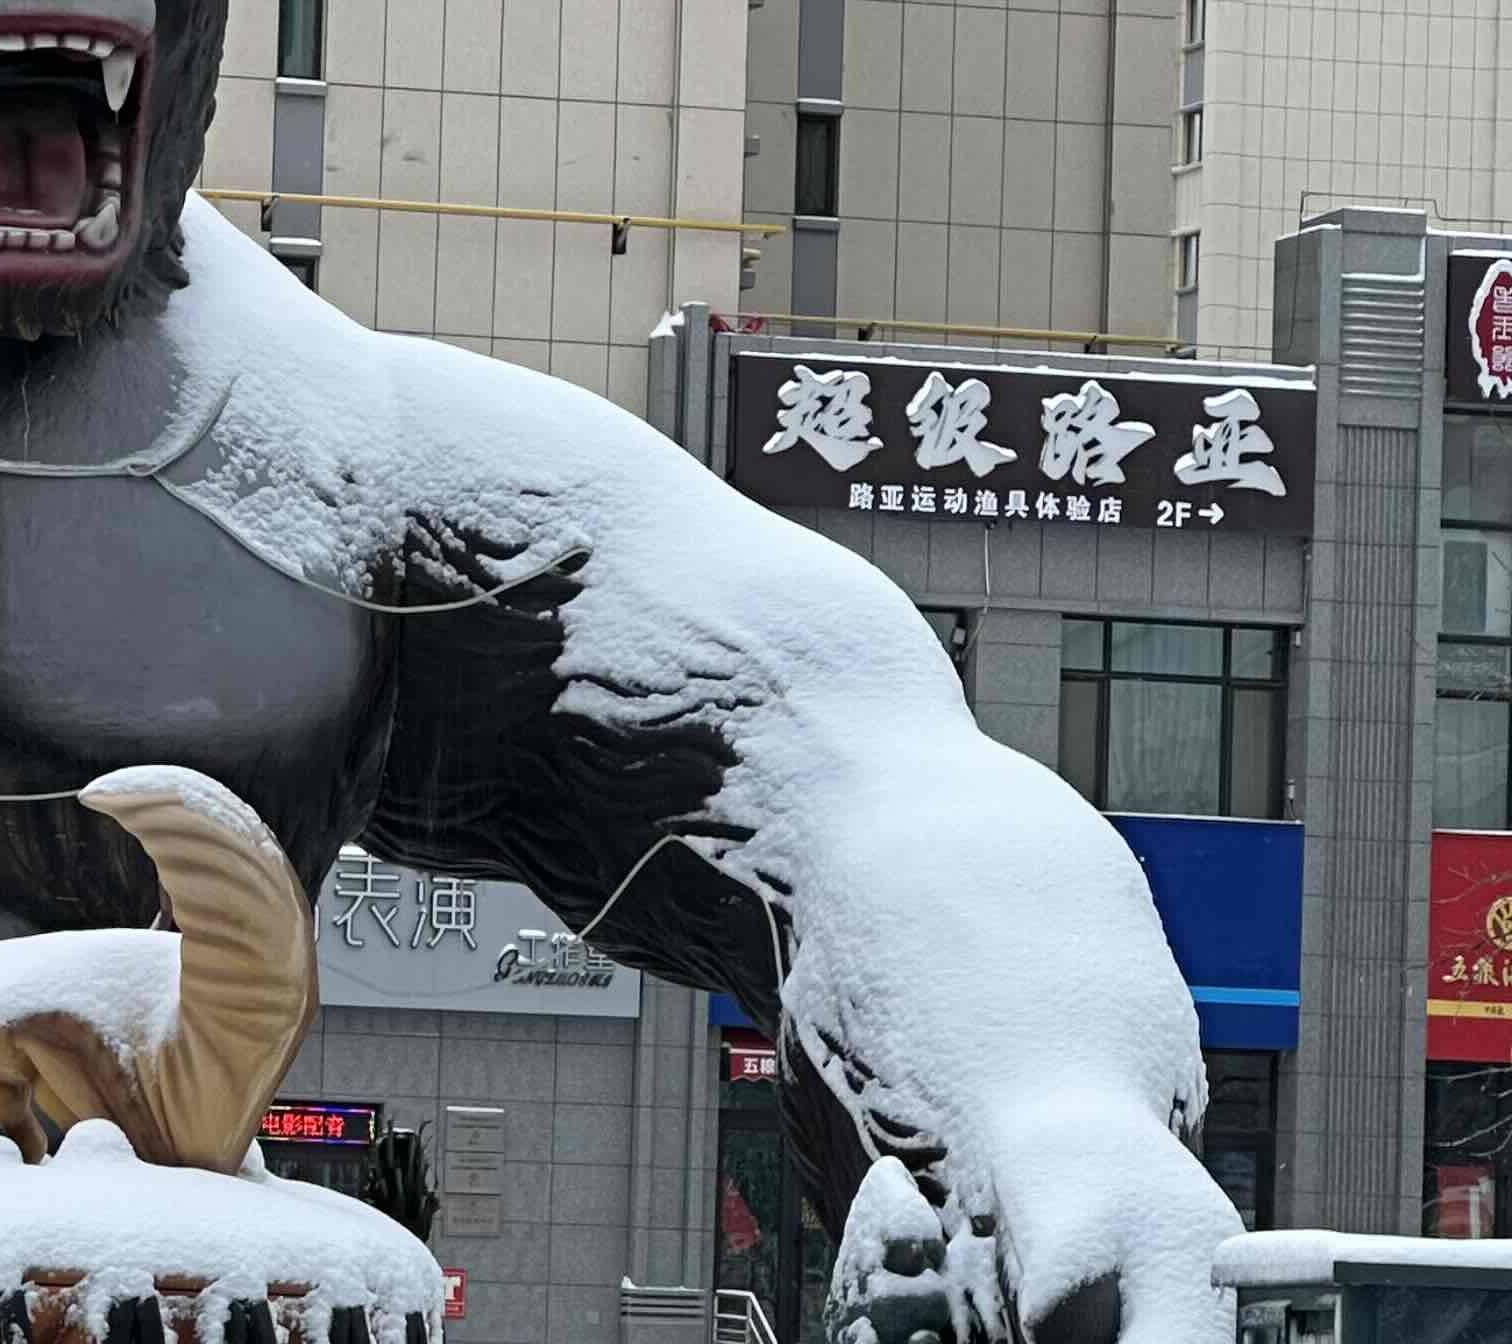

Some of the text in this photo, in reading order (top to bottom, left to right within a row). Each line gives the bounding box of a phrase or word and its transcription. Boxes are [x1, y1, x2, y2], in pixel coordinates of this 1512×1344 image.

[762, 364, 1287, 497] 超级路亚
[849, 482, 1192, 528] 路亚运动渔具体验店 2F
[314, 849, 478, 950] 表演
[262, 1113, 344, 1137] 电影配音
